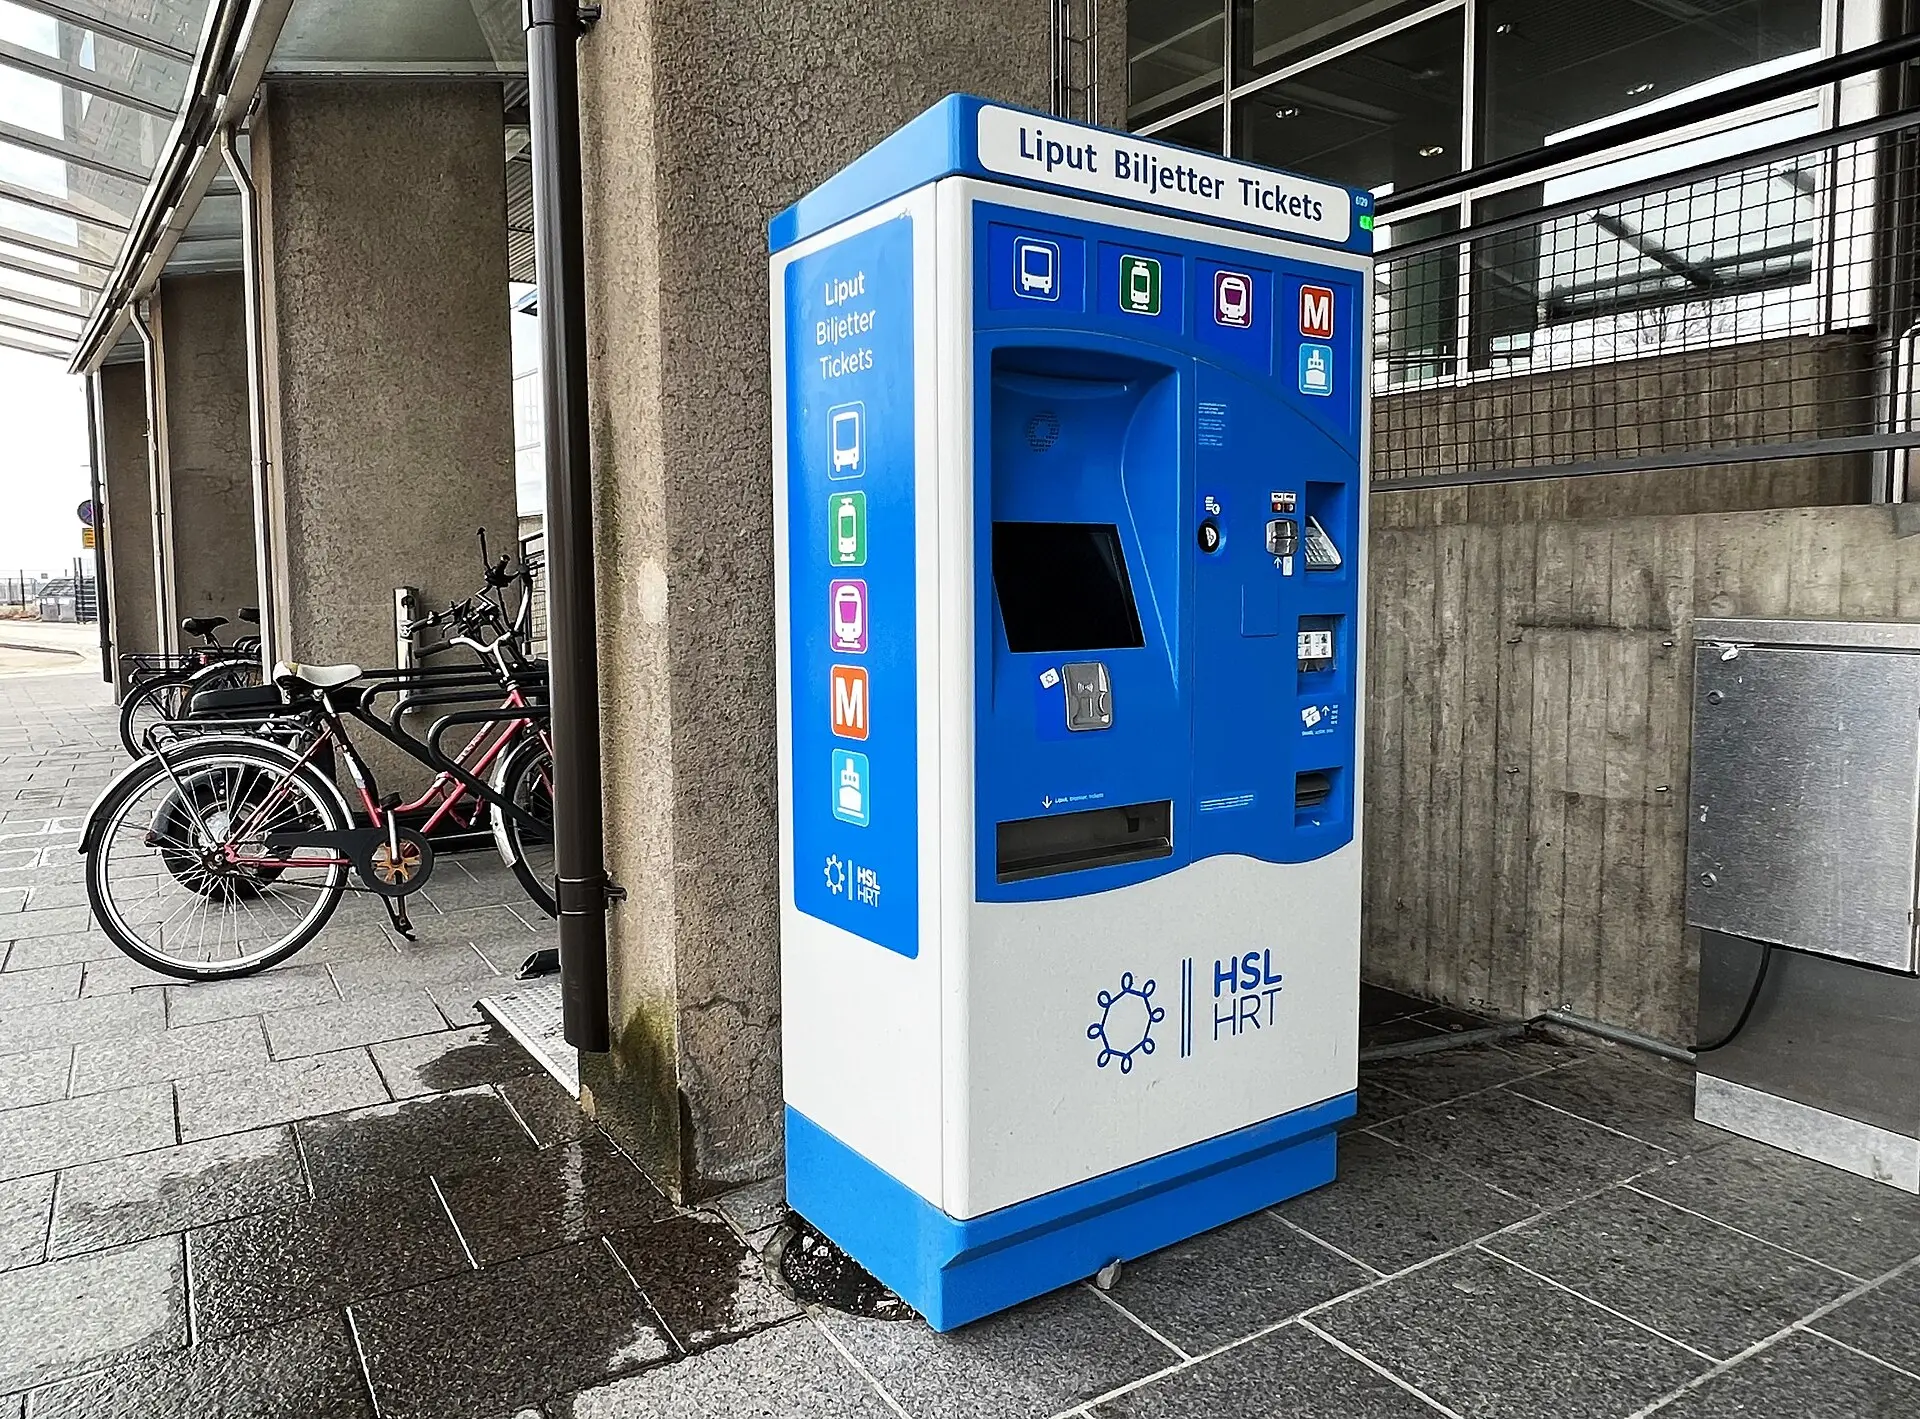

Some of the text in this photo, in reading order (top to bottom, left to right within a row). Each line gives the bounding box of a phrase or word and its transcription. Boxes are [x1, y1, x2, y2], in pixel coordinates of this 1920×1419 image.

[1019, 127, 1323, 222] Liput Biljetter Tickets
[825, 269, 865, 307] Liput
[816, 309, 876, 346] Biljetter
[1303, 293, 1329, 331] M
[819, 347, 873, 381] Tickets
[835, 676, 864, 729] M
[857, 865, 881, 891] HSL
[857, 883, 881, 908] HRT
[1214, 948, 1282, 998] HSL
[1213, 987, 1282, 1041] HRT
